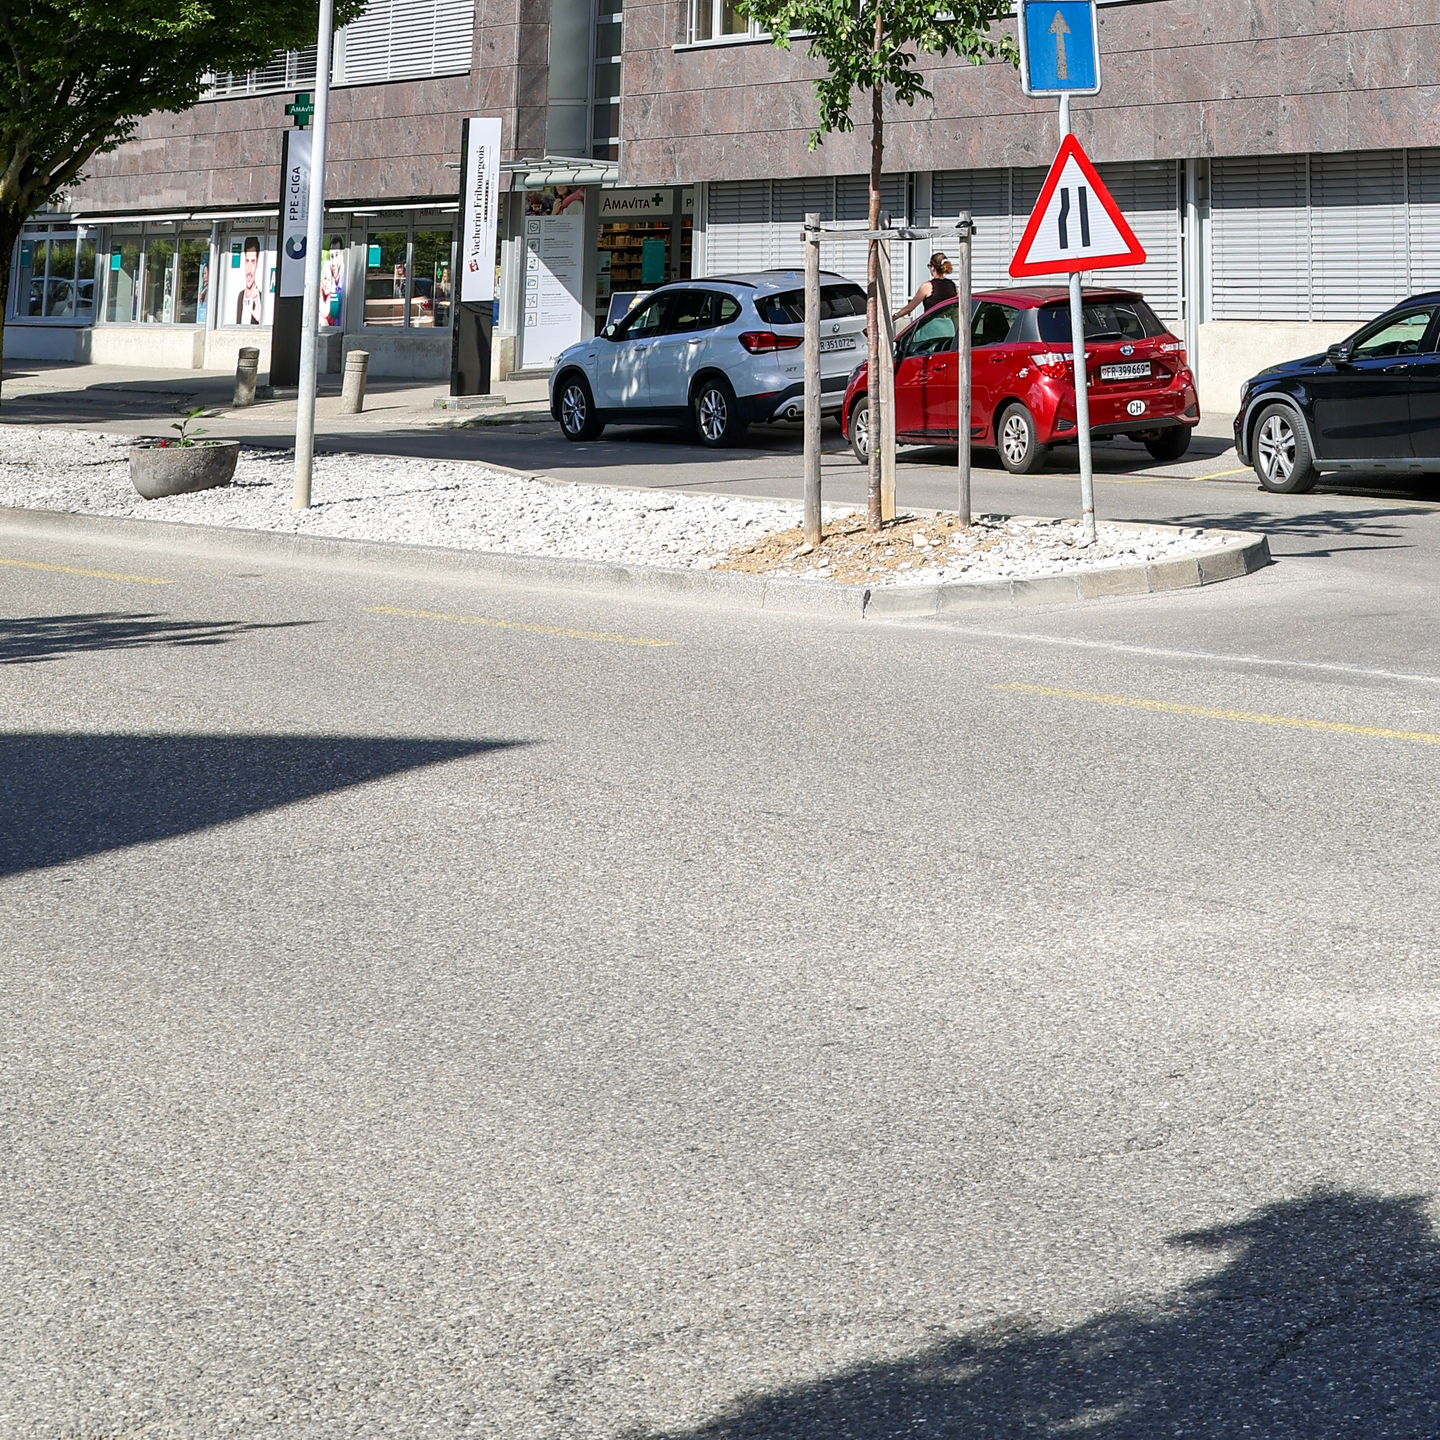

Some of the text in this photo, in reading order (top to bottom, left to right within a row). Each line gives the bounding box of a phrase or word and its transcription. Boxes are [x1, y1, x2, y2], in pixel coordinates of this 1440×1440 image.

[290, 105, 315, 113] AMAVIT
[473, 145, 485, 209] Fribourgeois
[289, 166, 301, 221] FPE-CIGA
[602, 197, 650, 212] AMAVITA
[1130, 402, 1142, 414] CH
